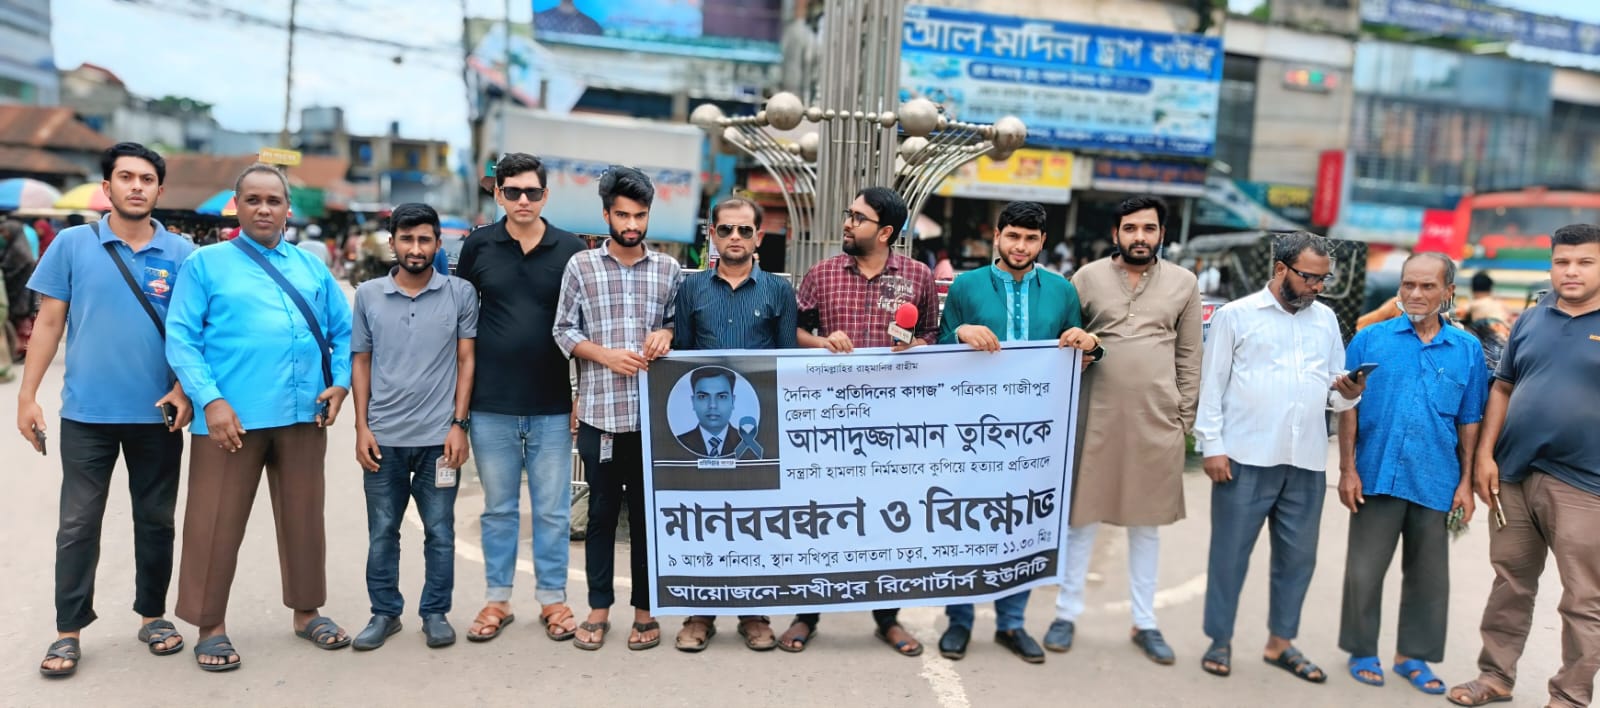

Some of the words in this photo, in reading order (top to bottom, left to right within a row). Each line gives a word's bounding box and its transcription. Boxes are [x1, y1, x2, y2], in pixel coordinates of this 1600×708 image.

[783, 385, 822, 402] দৈনিক
[950, 380, 998, 397] পত্রিকার
[1002, 378, 1050, 398] গাজীপুর
[785, 406, 816, 422] জেলা
[821, 403, 871, 420] প্রতিনিধি
[786, 421, 949, 457] আসাদুজ্জামান
[954, 414, 1053, 454] তুহিনকে
[827, 463, 866, 479] হামলায়
[871, 460, 925, 476] নির্মমভাবে
[971, 459, 1004, 473] হত্যার
[1008, 456, 1051, 472] প্রতিবাদে
[660, 496, 867, 542] মানববন্ধন
[879, 499, 912, 533] ও
[919, 486, 1056, 535] বিক্ষোভ
[668, 554, 677, 567] ৯
[770, 551, 793, 568] স্থান
[798, 547, 839, 567] সখিপুর
[844, 547, 892, 564] তালতলা
[876, 569, 979, 594] রিপোর্টার্স
[982, 556, 1049, 588] ইউনিটি
